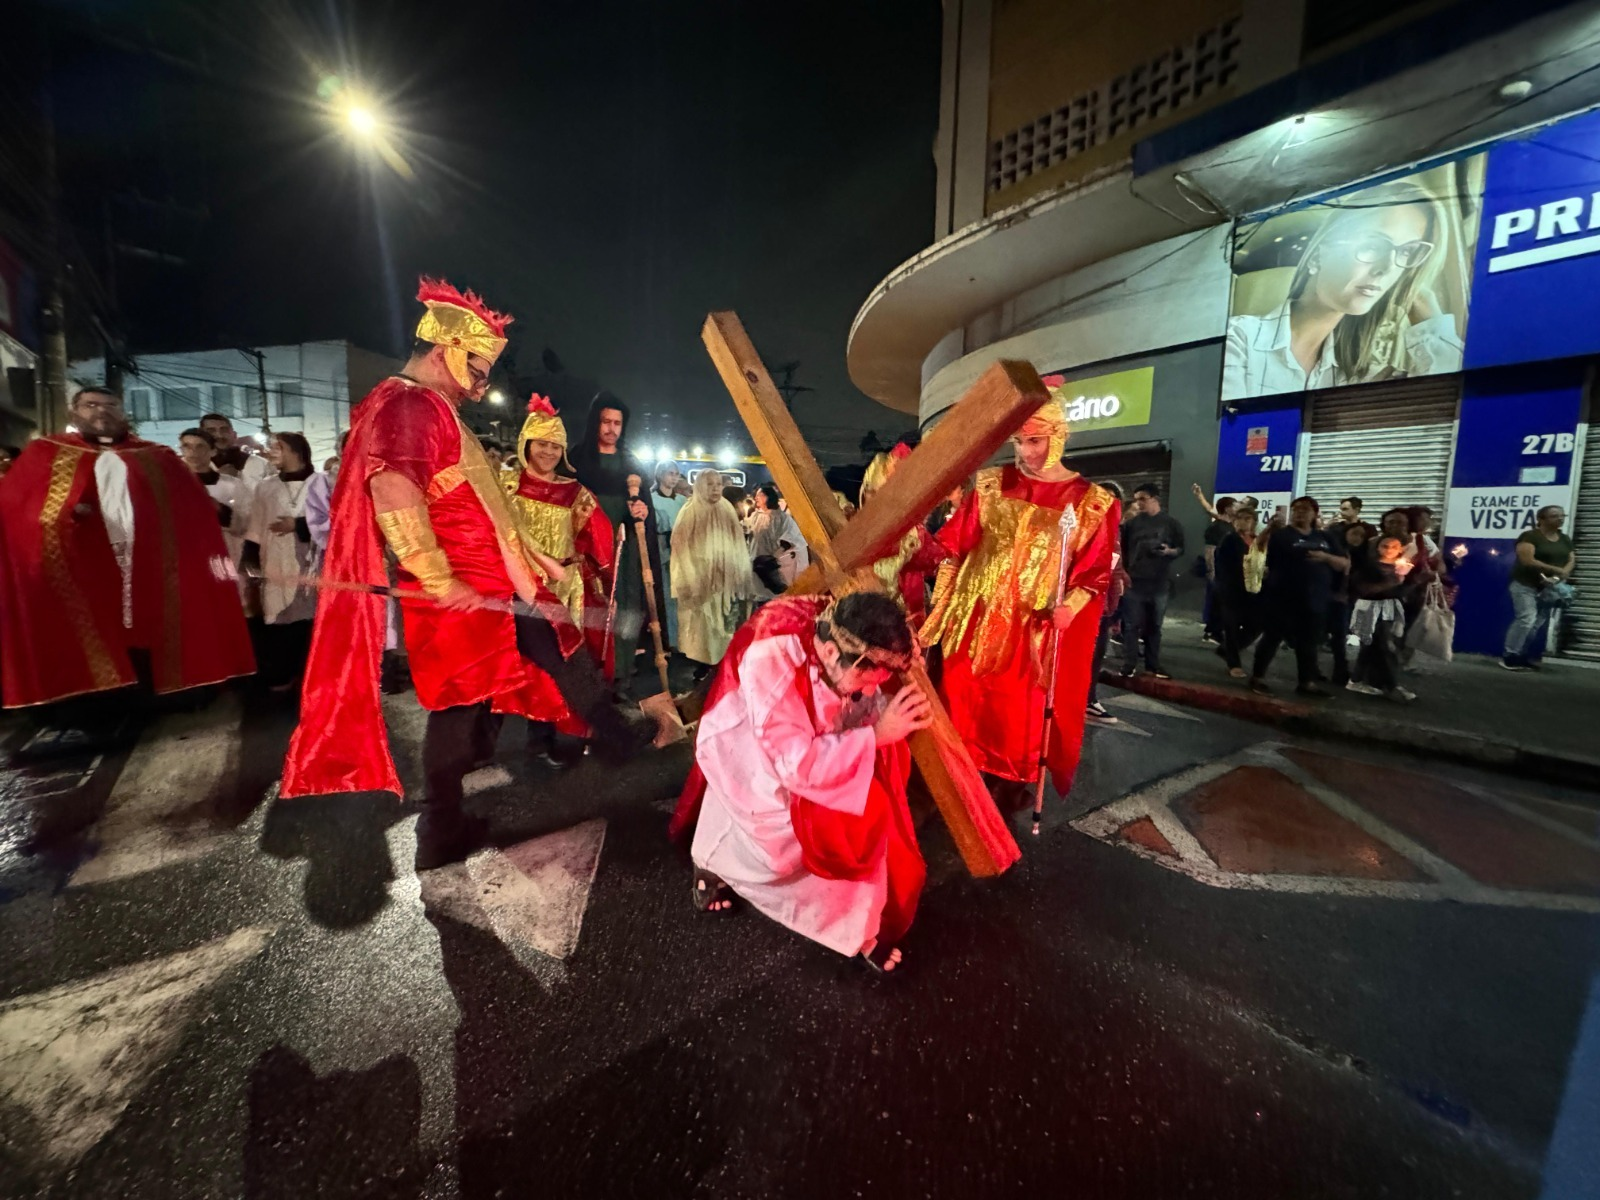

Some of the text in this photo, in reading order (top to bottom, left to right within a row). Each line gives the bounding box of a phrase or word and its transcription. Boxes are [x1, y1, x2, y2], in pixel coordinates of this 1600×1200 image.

[1521, 432, 1575, 455] 27B
[1260, 455, 1293, 472] 27A
[1261, 499, 1273, 510] DE
[1471, 495, 1541, 508] EXAME DE
[1470, 509, 1537, 530] VISTA
